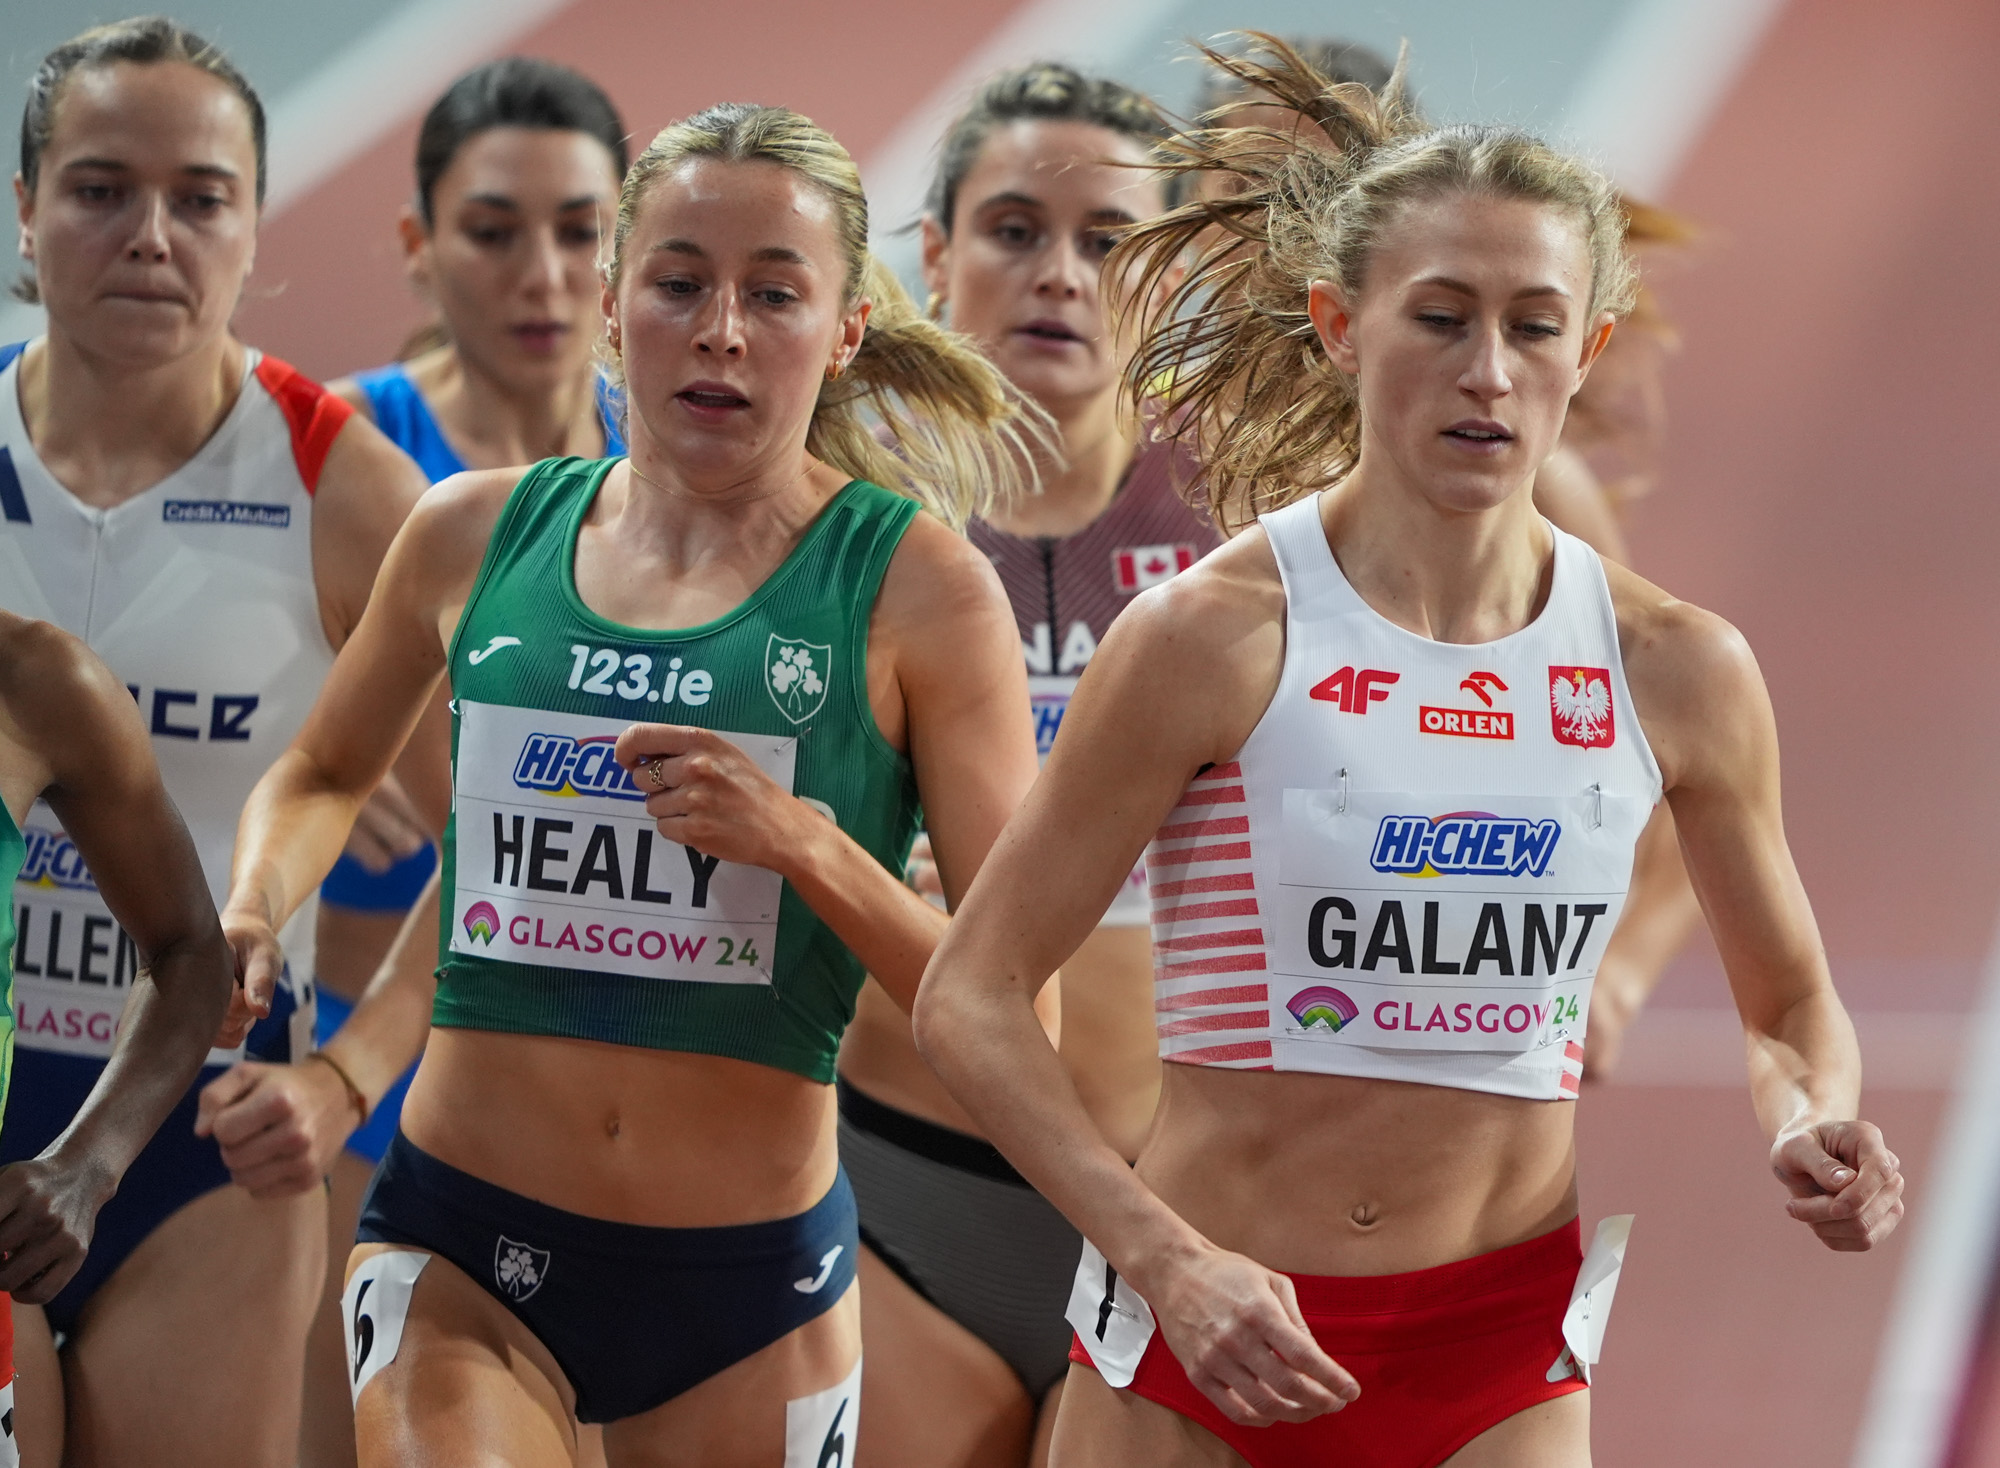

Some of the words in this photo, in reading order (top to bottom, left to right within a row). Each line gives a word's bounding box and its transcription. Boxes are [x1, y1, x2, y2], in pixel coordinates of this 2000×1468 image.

[233, 506, 289, 525] Mutuel
[567, 645, 713, 706] 123.ie
[1309, 665, 1401, 715] 4F
[1424, 710, 1509, 736] ORLEN
[493, 812, 723, 909] HEALY
[1370, 815, 1562, 878] HI-CHEW
[508, 916, 708, 964] GLASGOW
[715, 937, 760, 967] 24
[1307, 896, 1609, 977] GALANT
[17, 1002, 121, 1042] LASG
[1553, 994, 1579, 1025] 24
[354, 1278, 375, 1385] 6
